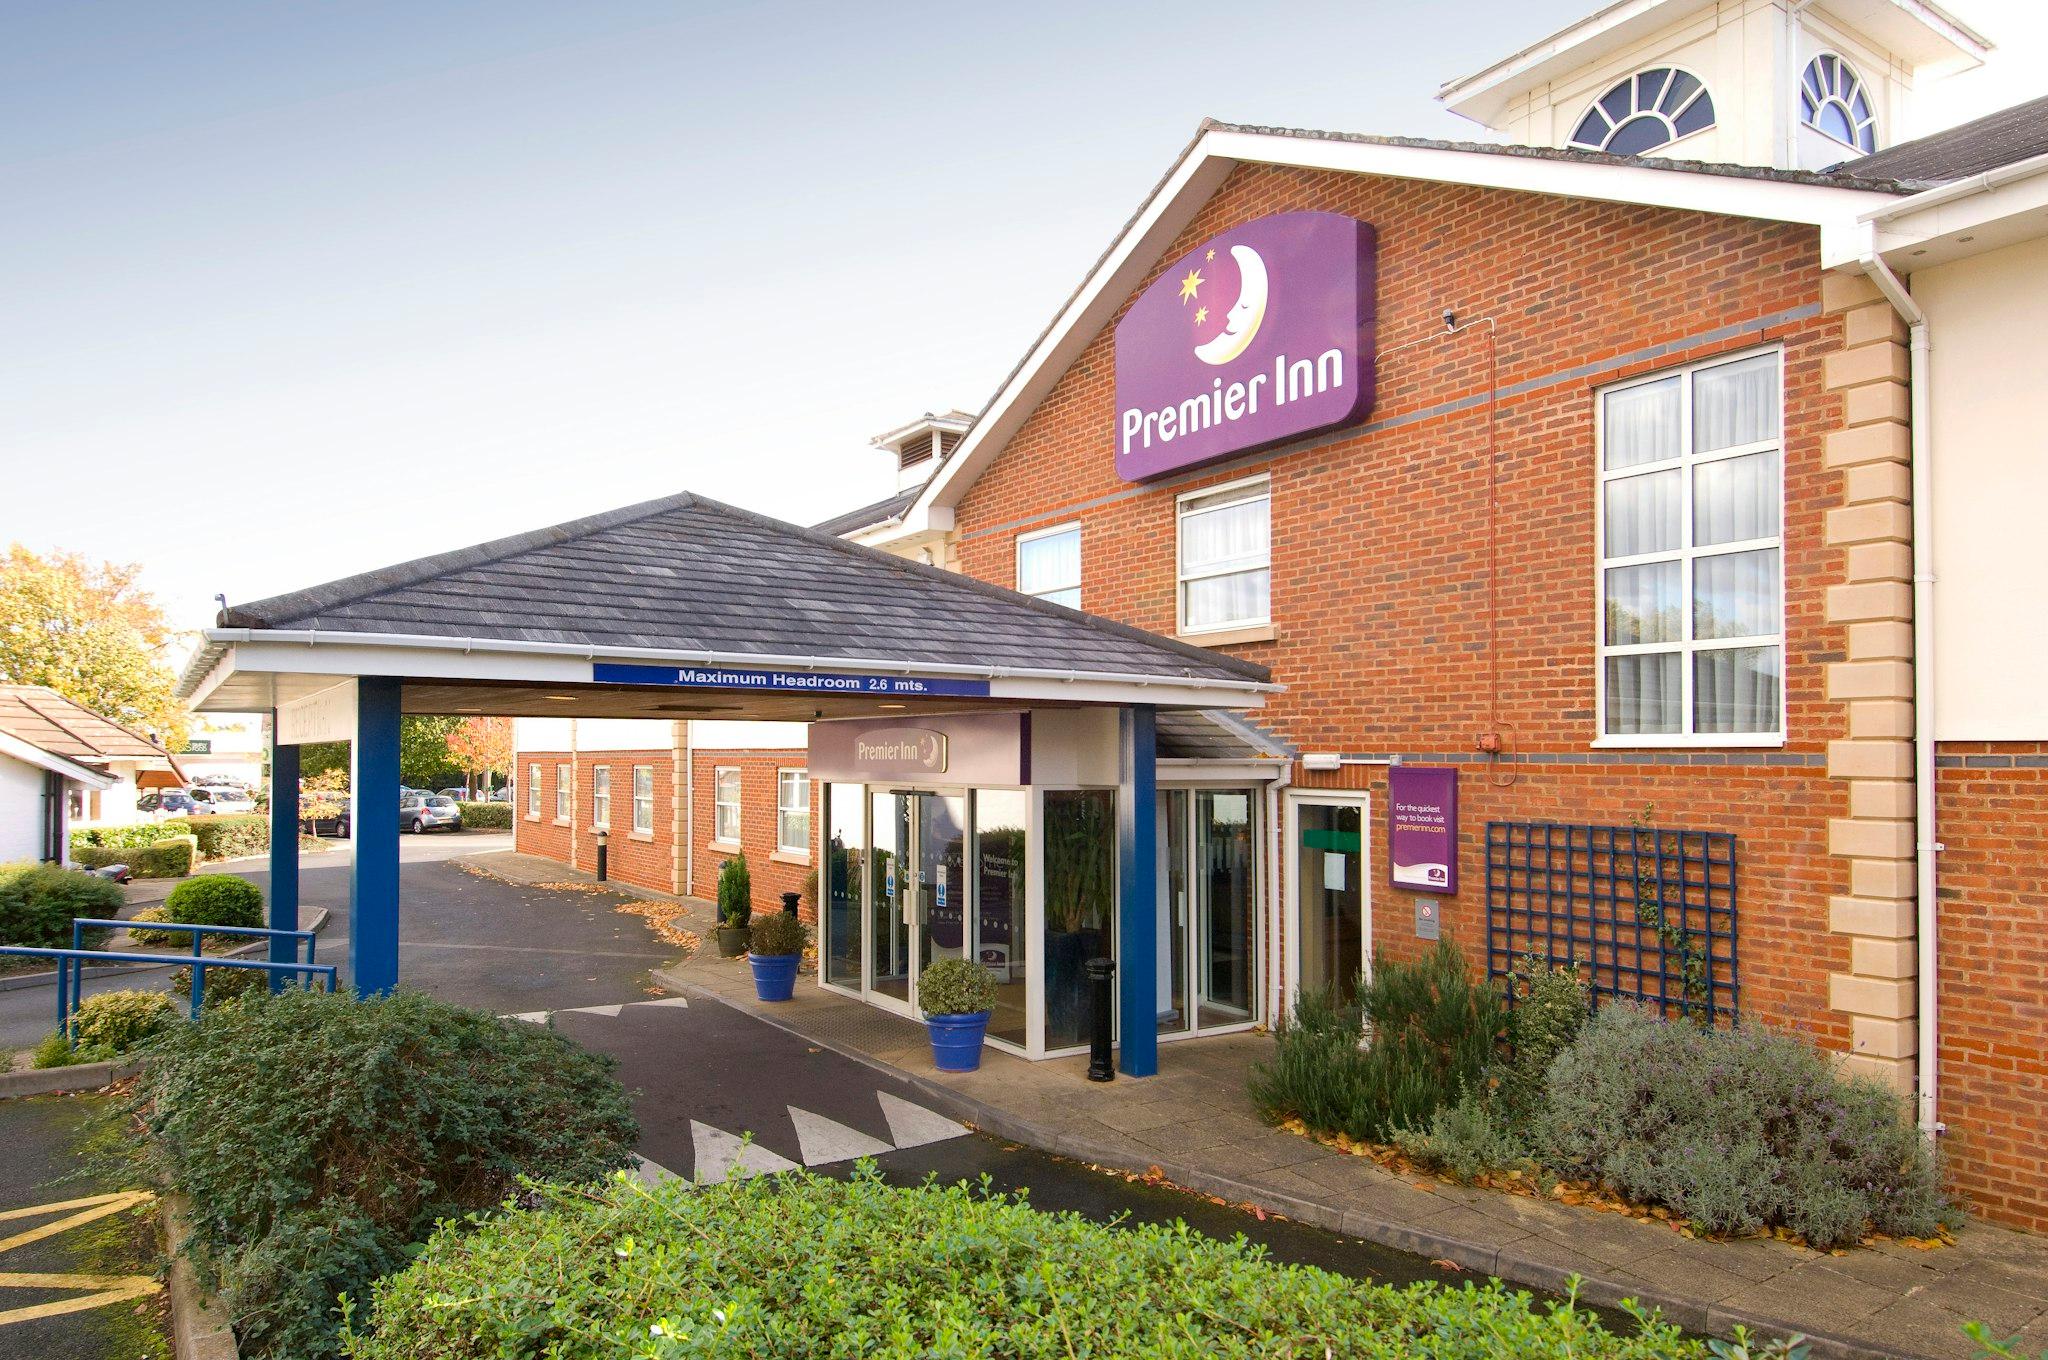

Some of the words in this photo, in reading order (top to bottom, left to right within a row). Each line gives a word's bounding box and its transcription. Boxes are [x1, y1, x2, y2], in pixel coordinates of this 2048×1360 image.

[1122, 374, 1267, 455] Premier
[1275, 348, 1343, 406] Inn
[679, 669, 767, 685] Maximum
[772, 673, 860, 689] Headroom
[868, 678, 888, 691] 2.6
[894, 681, 928, 692] mts.
[858, 740, 900, 761] Premier
[900, 740, 918, 761] Inn
[1396, 802, 1406, 811] For
[1407, 803, 1417, 812] the
[1417, 805, 1441, 814] quickest
[1409, 814, 1417, 822] to
[1417, 814, 1433, 823] book
[1433, 815, 1445, 824] visit
[1396, 823, 1446, 833] premierinn.com
[982, 852, 1011, 866] Welcome
[1011, 858, 1019, 866] to
[983, 865, 1008, 878] Premier
